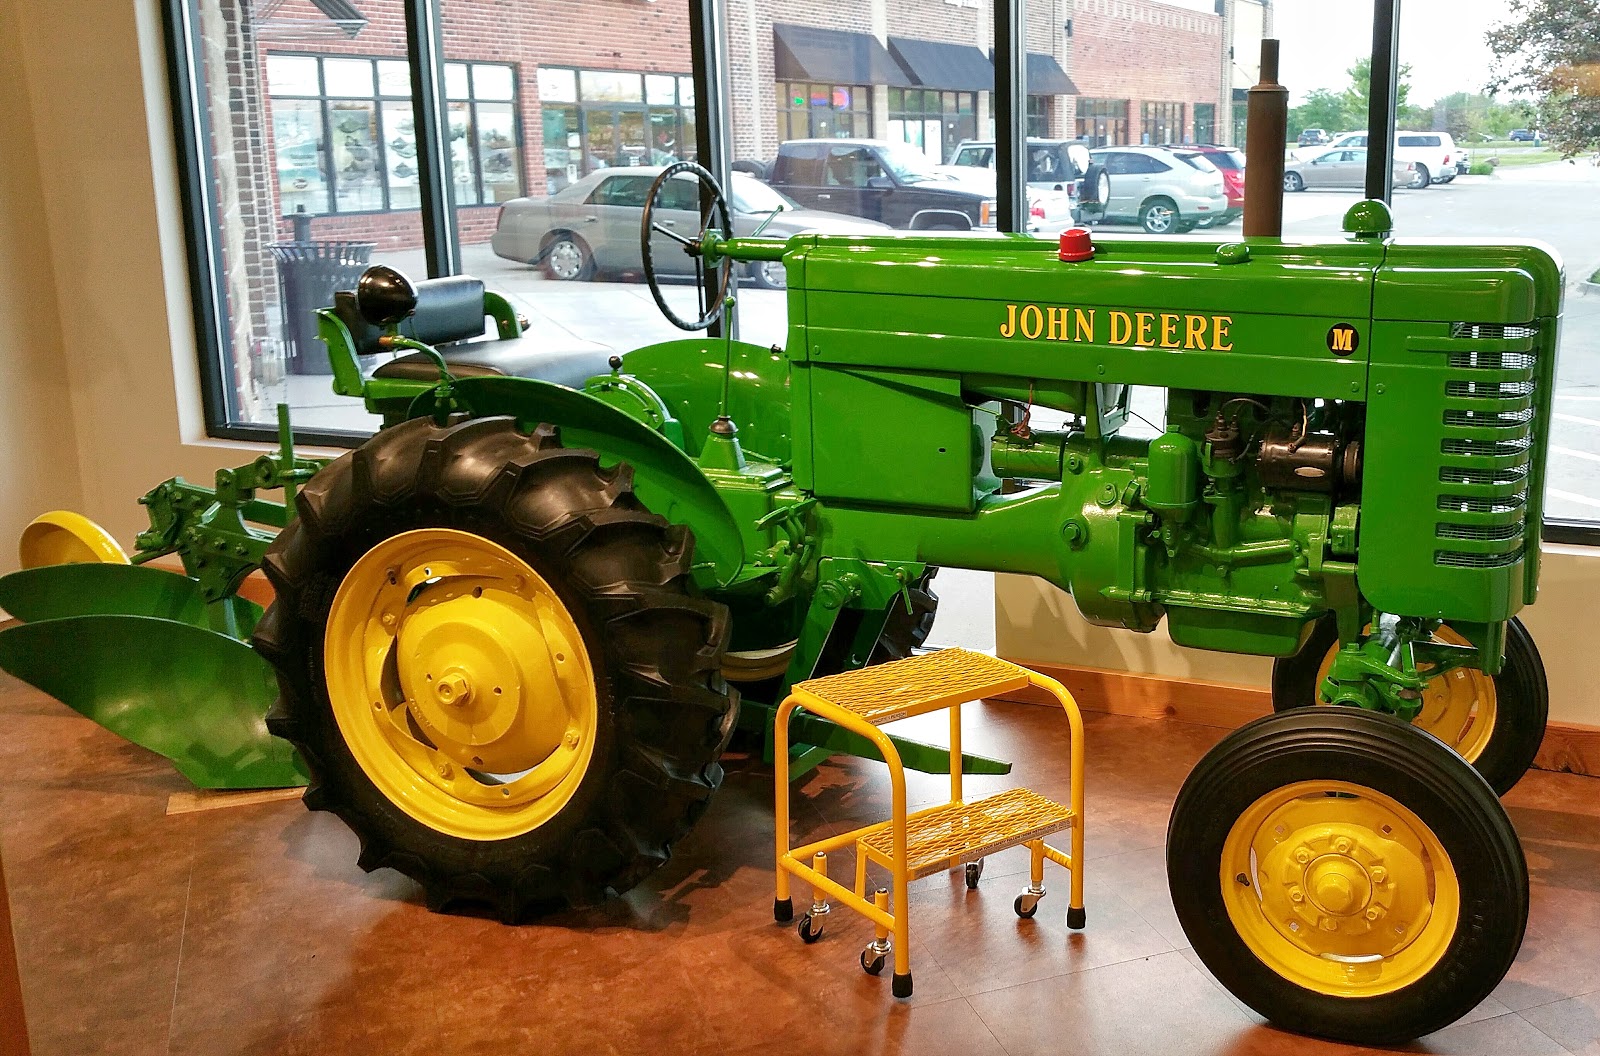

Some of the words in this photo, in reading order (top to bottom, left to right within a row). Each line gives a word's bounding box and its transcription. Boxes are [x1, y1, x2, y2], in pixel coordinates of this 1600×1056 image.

[1000, 304, 1096, 343] JOHN
[1108, 310, 1234, 351] DEERE
[1331, 328, 1353, 351] M
